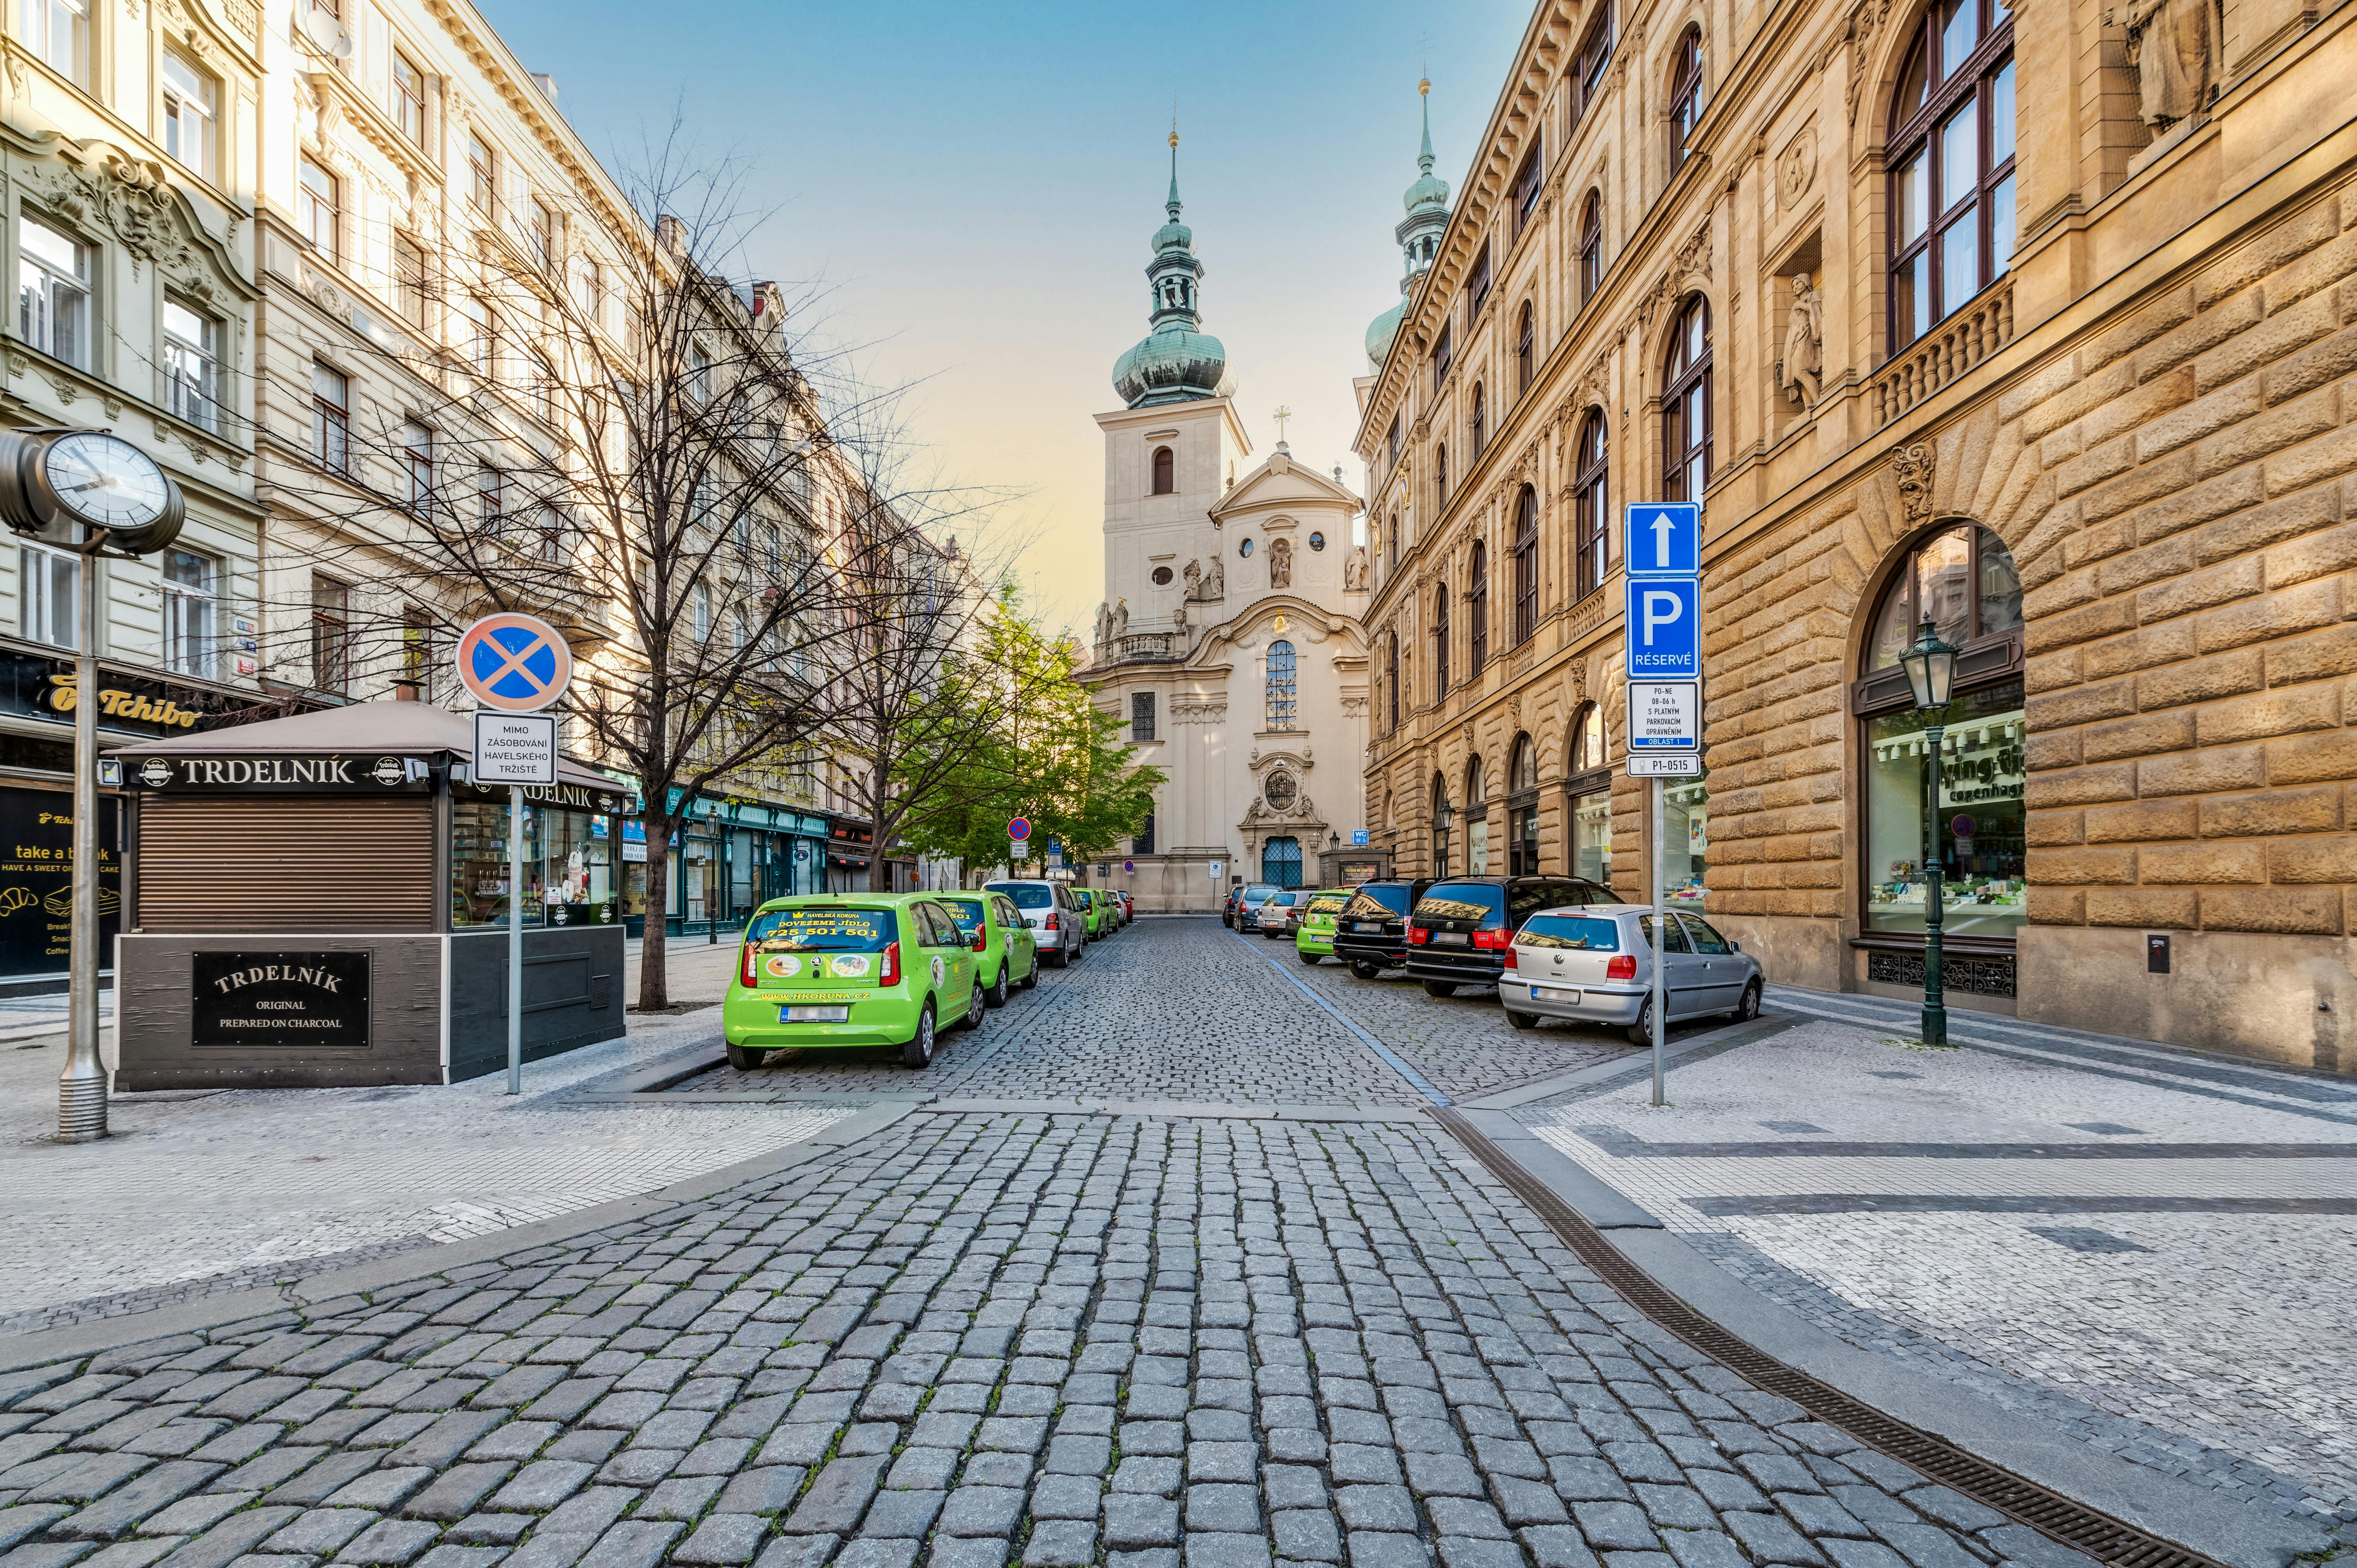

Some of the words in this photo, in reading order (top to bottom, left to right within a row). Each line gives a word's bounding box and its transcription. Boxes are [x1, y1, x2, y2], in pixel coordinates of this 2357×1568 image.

[1643, 591, 1682, 646] P
[1636, 652, 1691, 665] RÉSERVÉ
[99, 690, 202, 727] Tchibo
[1654, 706, 1679, 715] PLATNÝM
[1647, 717, 1680, 725] PARKOVACÍM
[1646, 727, 1681, 735] OPRÁVNĚNÍM
[488, 738, 547, 747] ZÁSOBOVÁNÍ
[485, 752, 548, 760] HAVELSKÉHO
[180, 754, 354, 784] TRDELNÍK
[499, 765, 537, 773] TRŽIŠTĚ
[1653, 760, 1687, 770] P1-0515
[743, 809, 767, 819] KORUNA
[53, 816, 74, 824] Tchi
[16, 846, 50, 858] take
[55, 849, 63, 859] a
[767, 928, 799, 937] 725
[845, 929, 878, 937] 501
[215, 966, 342, 994] TRDELNÍK
[288, 1019, 342, 1028] CHARCOAL
